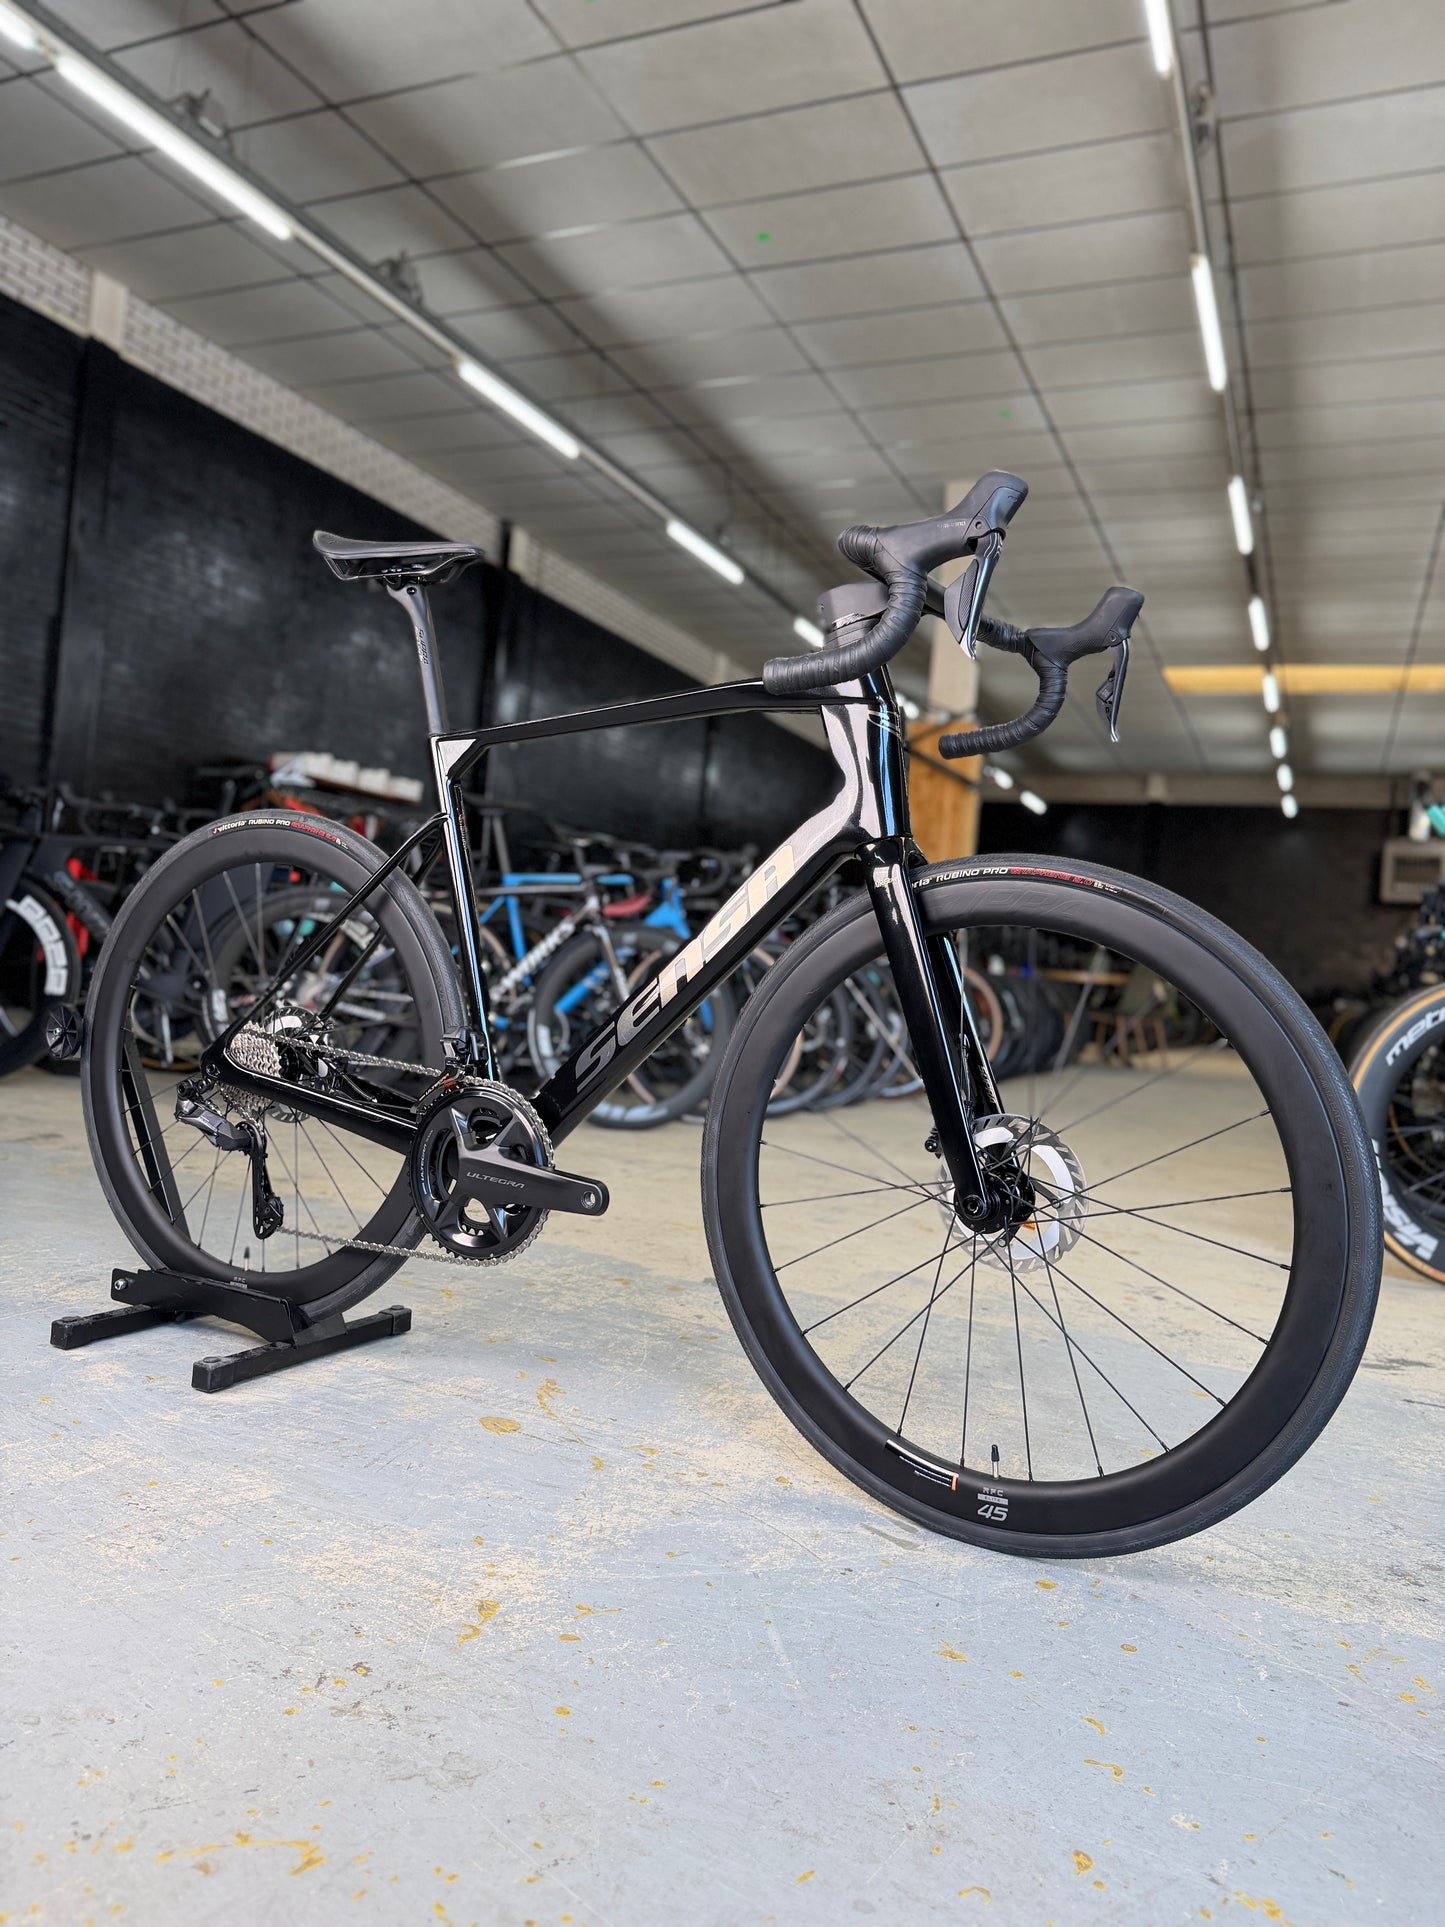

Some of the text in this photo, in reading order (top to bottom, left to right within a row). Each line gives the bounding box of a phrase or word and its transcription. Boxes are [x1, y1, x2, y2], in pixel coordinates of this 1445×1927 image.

[218, 820, 247, 832] vittoria
[275, 819, 291, 827] PRO
[935, 869, 979, 883] RUBINO
[982, 867, 1009, 875] PRO
[466, 1171, 526, 1189] ULTEGRA
[982, 1486, 1004, 1497] RFC
[977, 1504, 1009, 1522] 45
